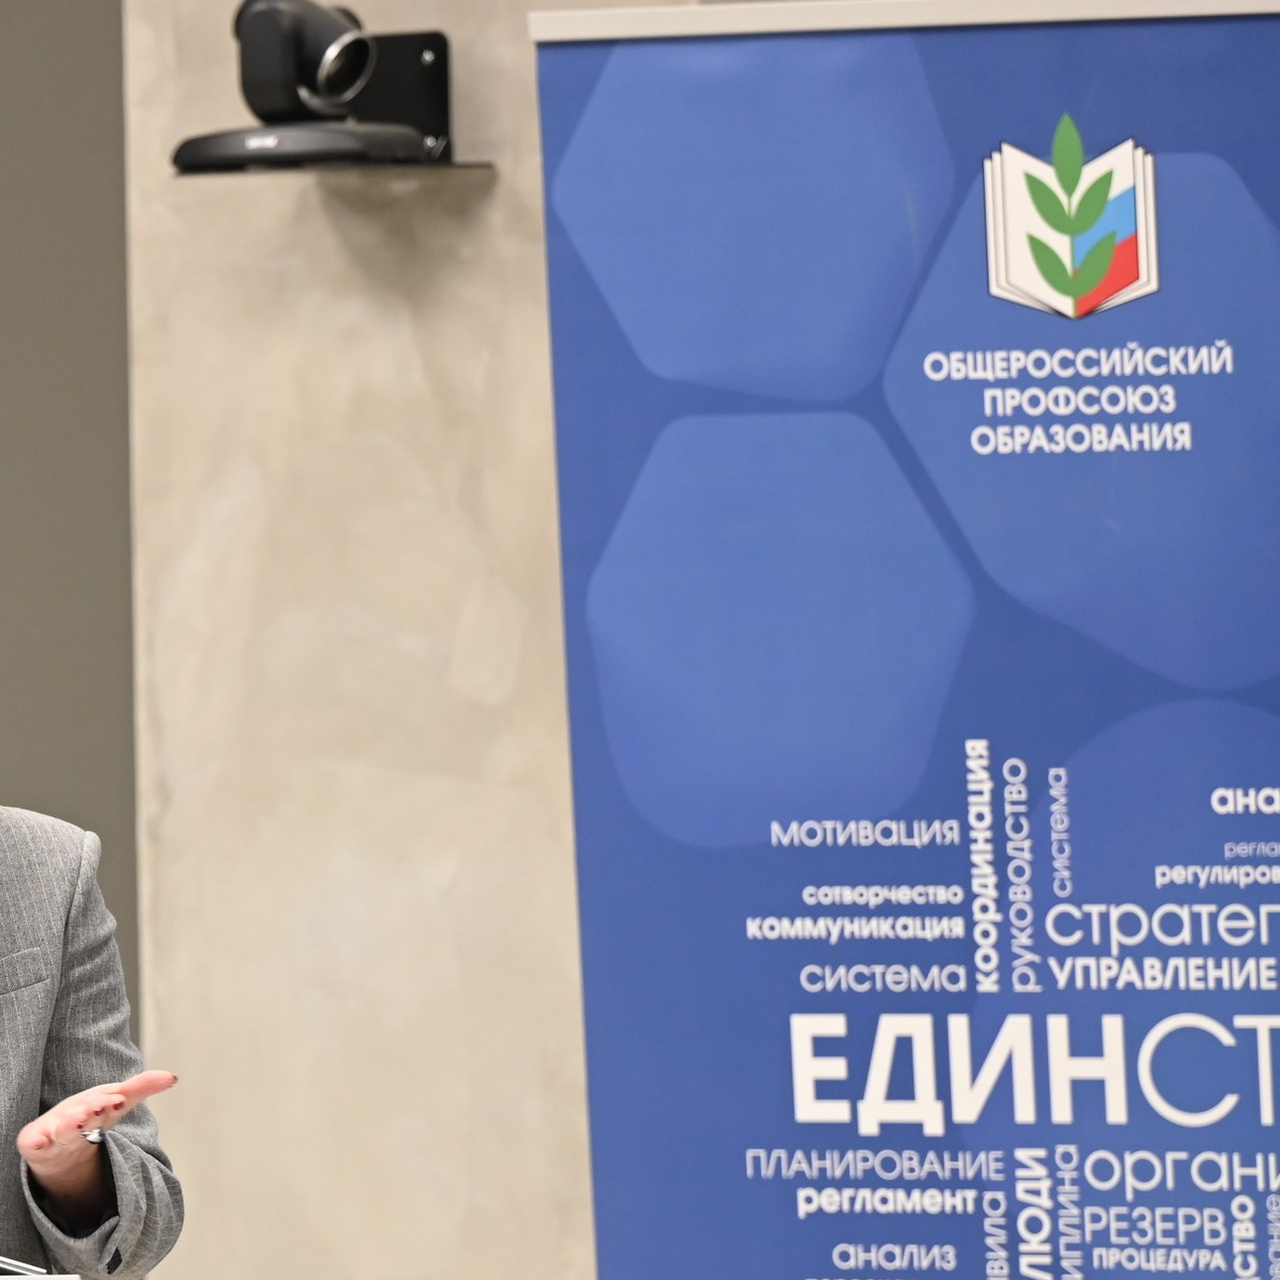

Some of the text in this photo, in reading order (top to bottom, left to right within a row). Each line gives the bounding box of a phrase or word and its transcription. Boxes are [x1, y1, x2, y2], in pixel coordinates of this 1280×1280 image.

[923, 340, 1233, 382] ОБЩЕРОССИЙСКИЙ
[983, 385, 1177, 417] ПРОФСОЮЗ
[970, 422, 1192, 455] ОБРАЗОВАНИЯ
[770, 819, 960, 848] мотивация
[1047, 767, 1073, 898] система
[963, 738, 1004, 993] координация
[1001, 757, 1043, 993] руководство
[801, 884, 964, 909] сотворчество
[746, 916, 965, 945] коммуникация
[799, 964, 967, 993] система
[1047, 955, 1278, 990] УПРАВЛЕНИЕ
[789, 1012, 1280, 1137] ЕДИНСТ
[745, 1148, 1005, 1180] ПЛАНИРОВАНИЕ
[797, 1187, 978, 1219] регламент
[1083, 1206, 1227, 1246] РЕЗЕРВ
[831, 1243, 957, 1271] анализ
[1092, 1247, 1227, 1273] ПРОЦЕДУРА
